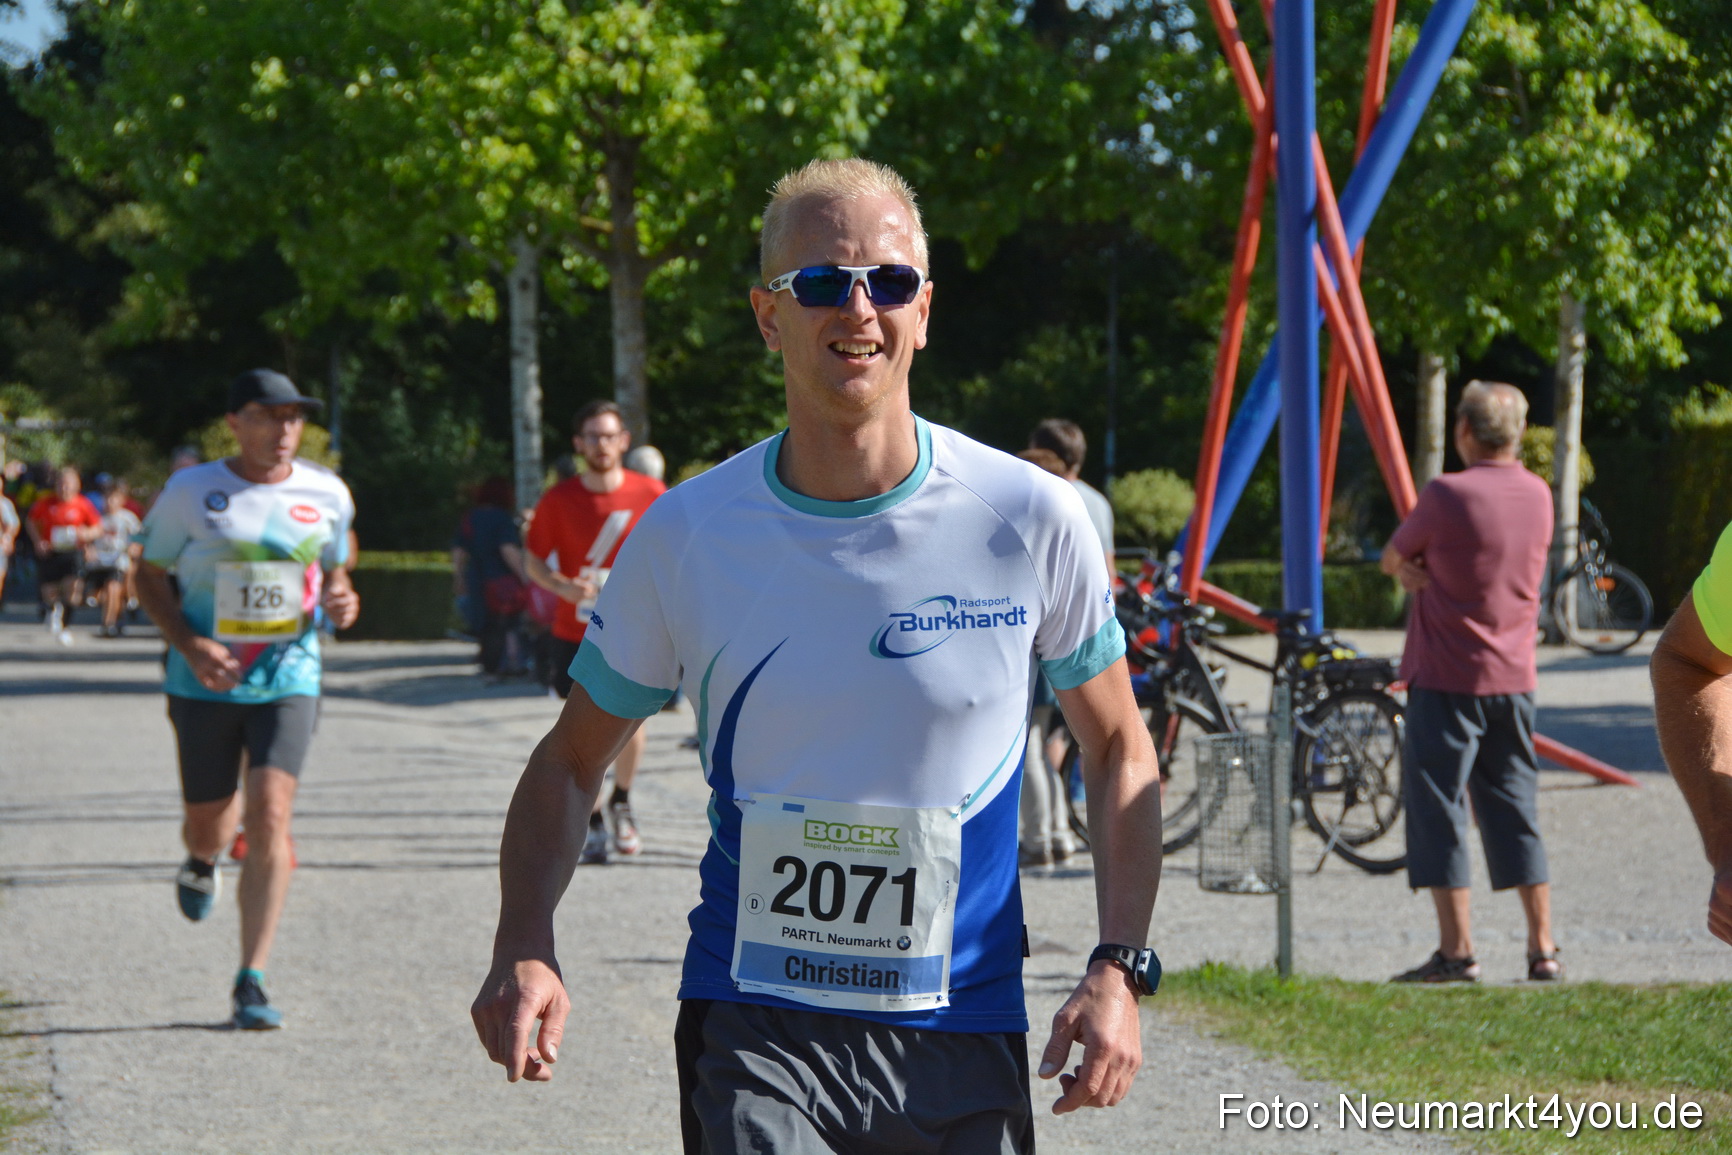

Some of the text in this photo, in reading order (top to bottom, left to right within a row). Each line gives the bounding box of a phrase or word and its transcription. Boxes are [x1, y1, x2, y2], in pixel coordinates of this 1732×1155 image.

[238, 585, 283, 609] 126
[960, 596, 1011, 608] Radsport
[889, 606, 1027, 632] Burkhardt
[804, 819, 900, 848] BOCK
[804, 841, 831, 851] inspired
[833, 844, 842, 852] by
[867, 848, 900, 857] concepts
[770, 855, 917, 927] 2071
[751, 898, 759, 910] D
[781, 926, 892, 949] PARTL Neumarkt
[785, 955, 900, 990] Christian
